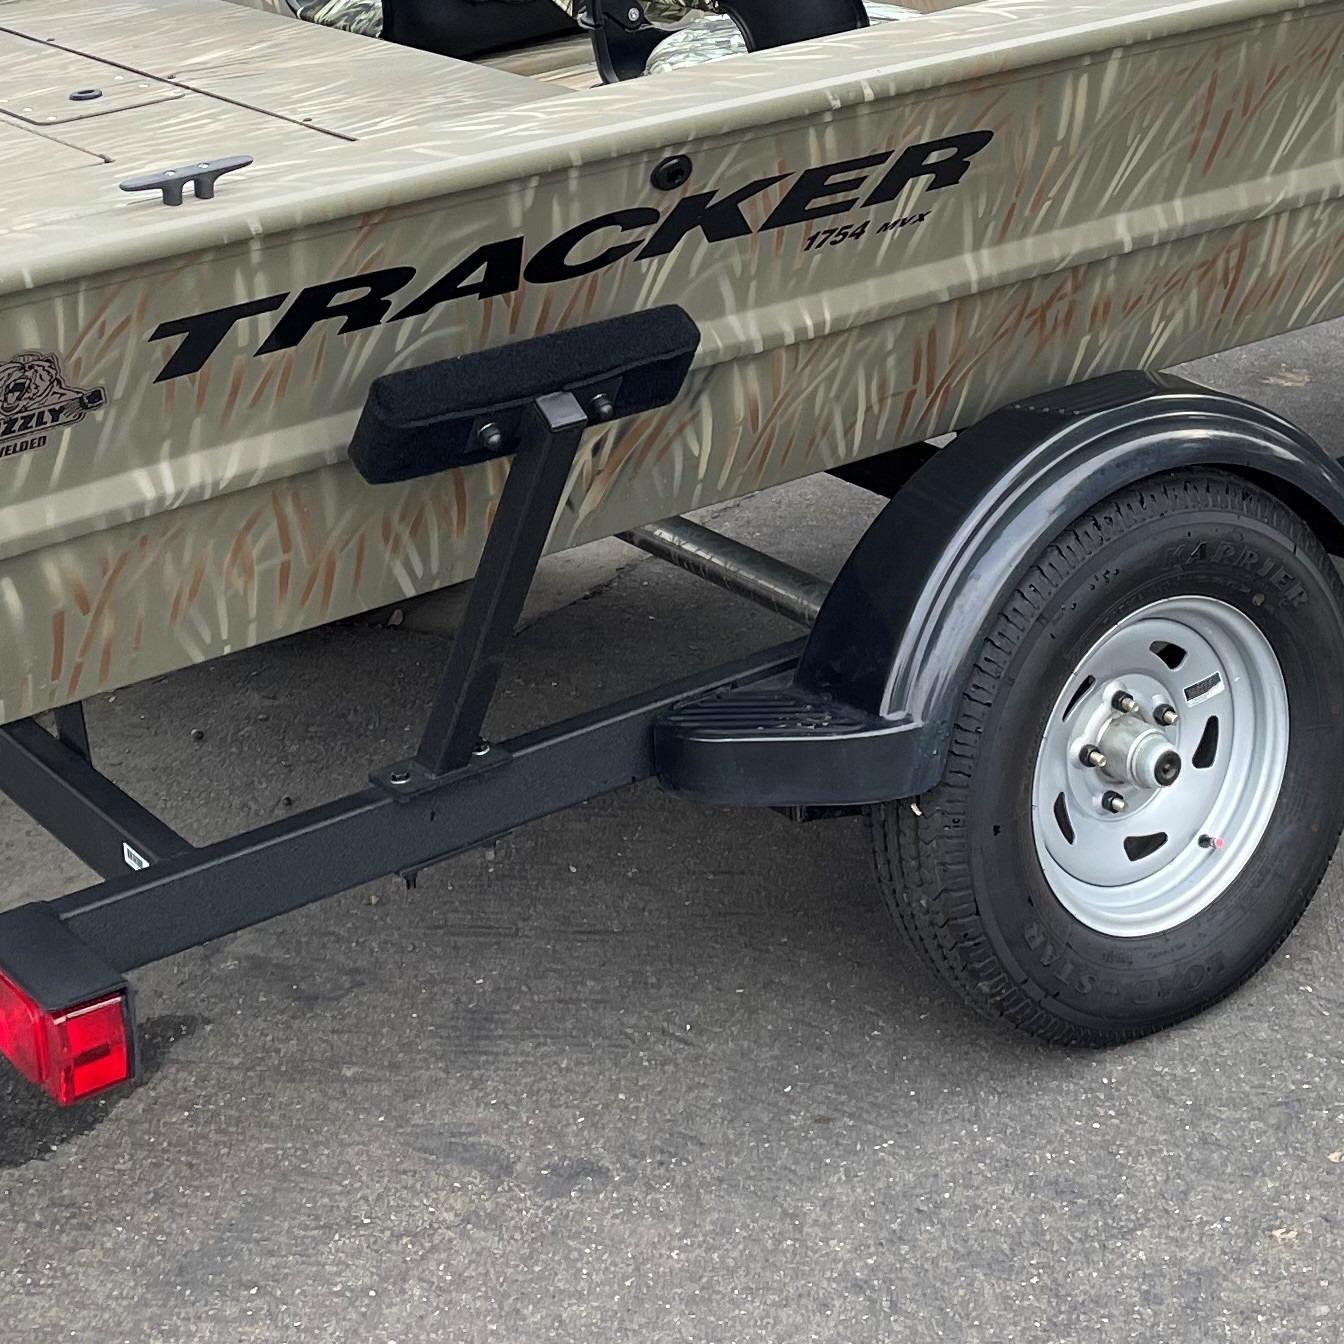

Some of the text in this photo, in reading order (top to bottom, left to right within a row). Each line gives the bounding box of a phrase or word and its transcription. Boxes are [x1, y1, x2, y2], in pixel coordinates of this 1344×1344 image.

[148, 130, 995, 383] TRACKER
[804, 211, 932, 252] 1754 MVX
